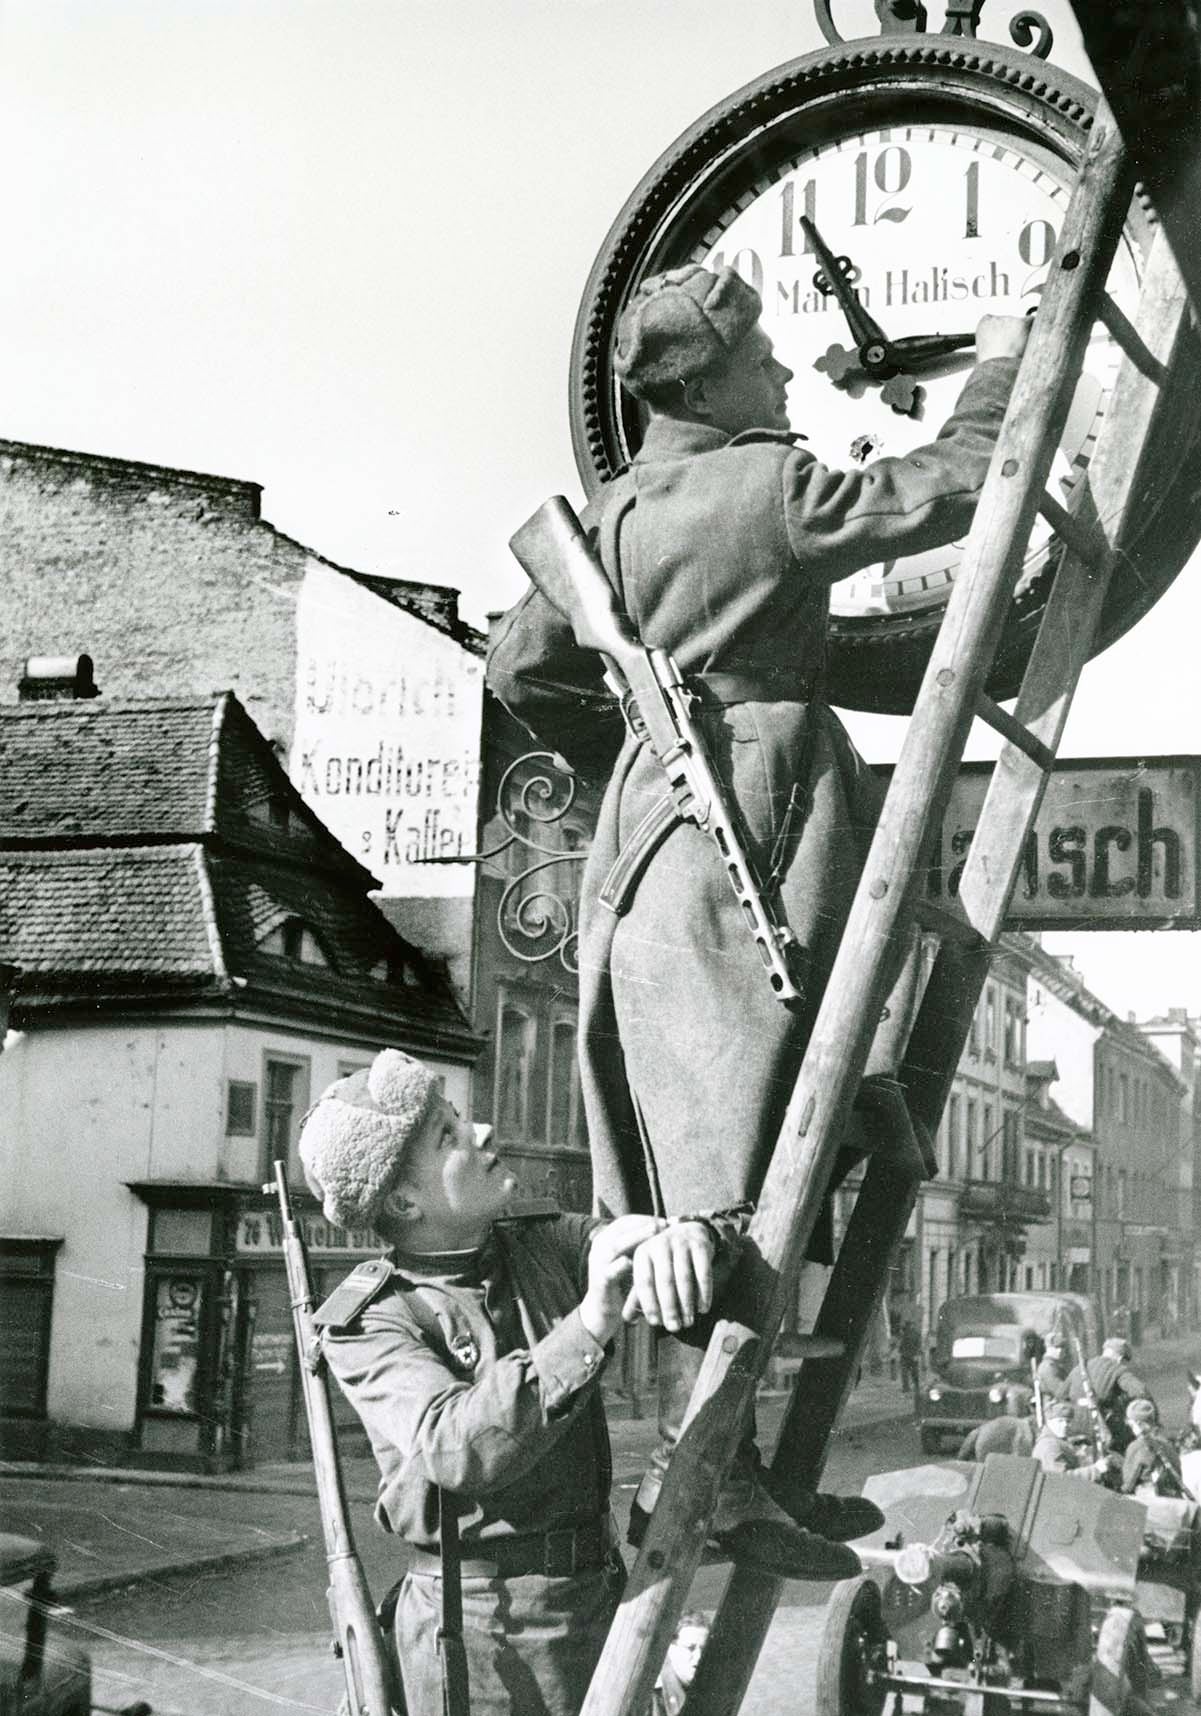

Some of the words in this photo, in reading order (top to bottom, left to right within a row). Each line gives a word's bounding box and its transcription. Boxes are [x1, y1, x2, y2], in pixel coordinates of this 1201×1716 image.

[777, 179, 817, 258] 11
[850, 146, 914, 227] 12
[962, 161, 983, 239] 1
[776, 279, 871, 316] Marn
[885, 262, 1011, 307] Halisch
